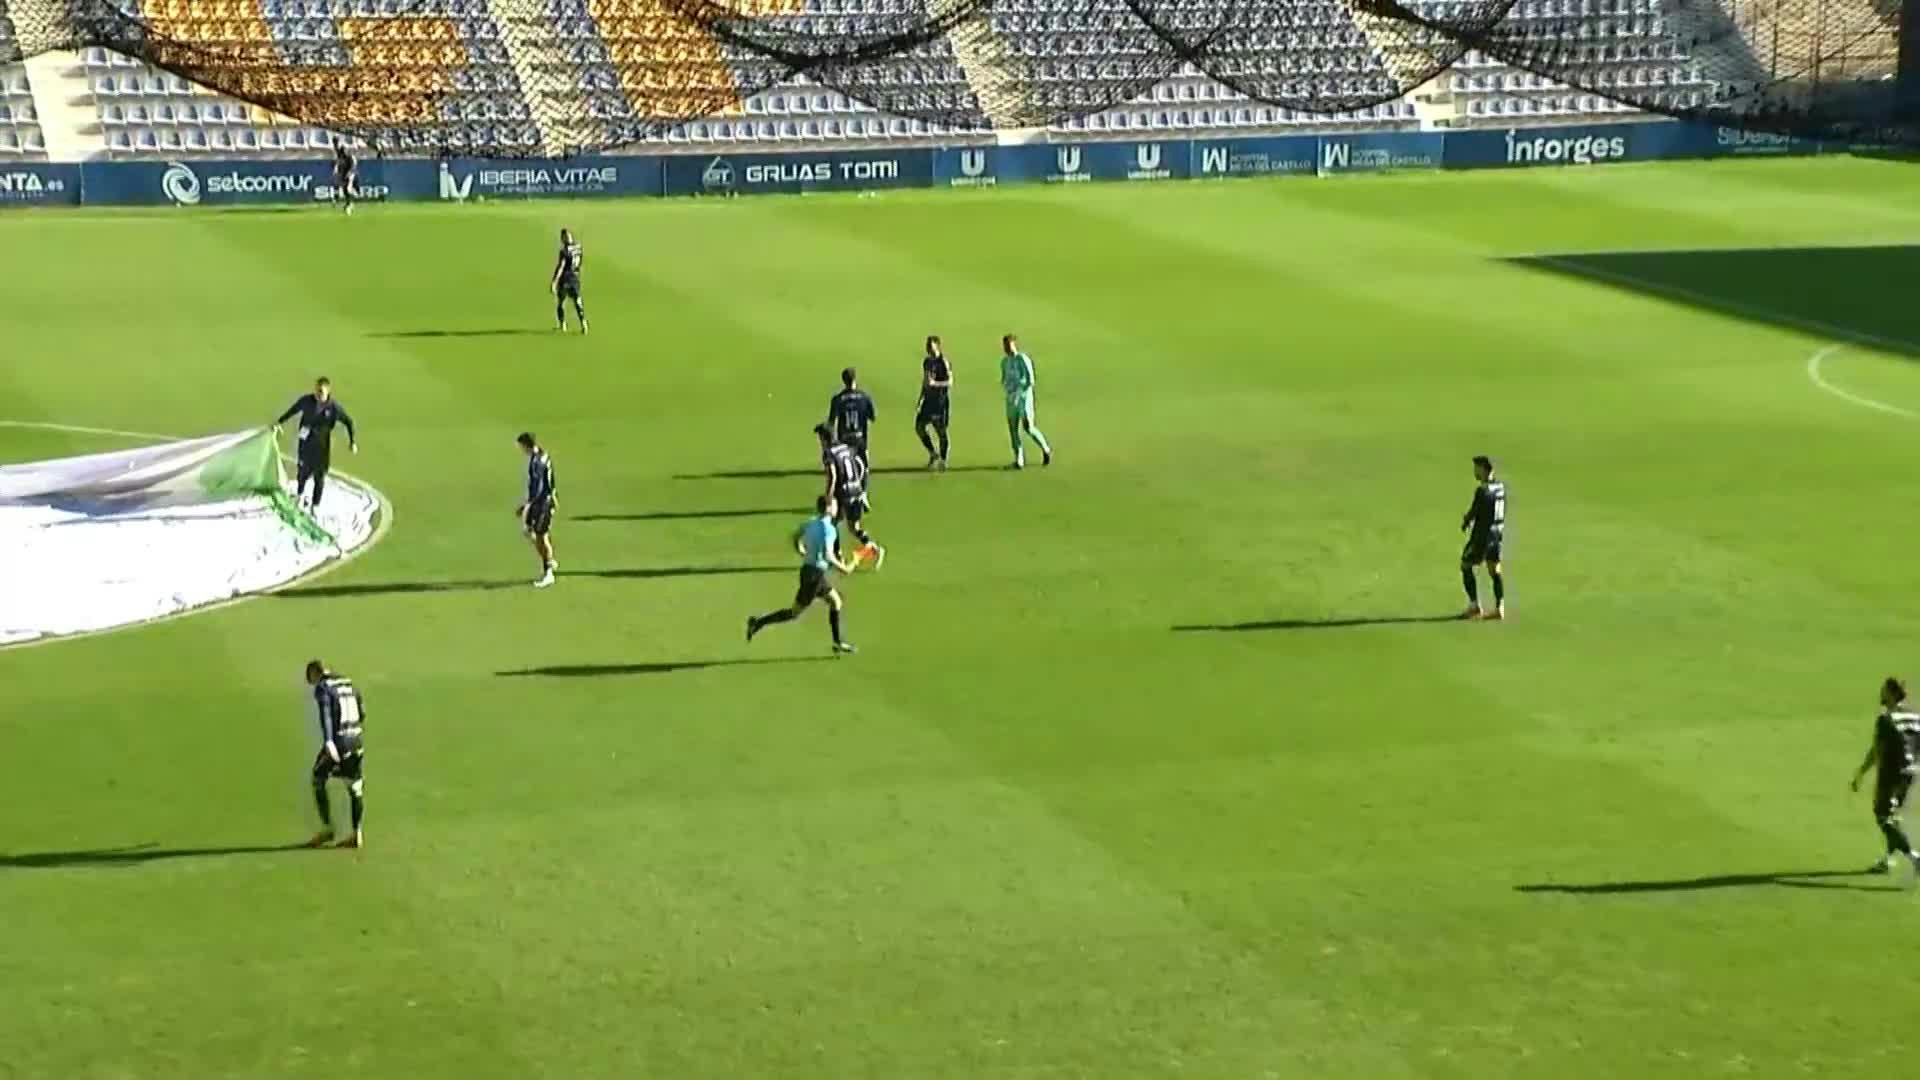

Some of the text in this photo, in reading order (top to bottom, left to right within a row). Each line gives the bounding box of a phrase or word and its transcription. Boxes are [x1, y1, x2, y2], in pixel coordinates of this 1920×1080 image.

[1505, 128, 1625, 164] inforges
[207, 171, 313, 193] setcomur
[479, 167, 618, 185] IBERIA VITAE
[746, 160, 899, 183] GRUAS TOMI
[313, 185, 389, 200] SHRP
